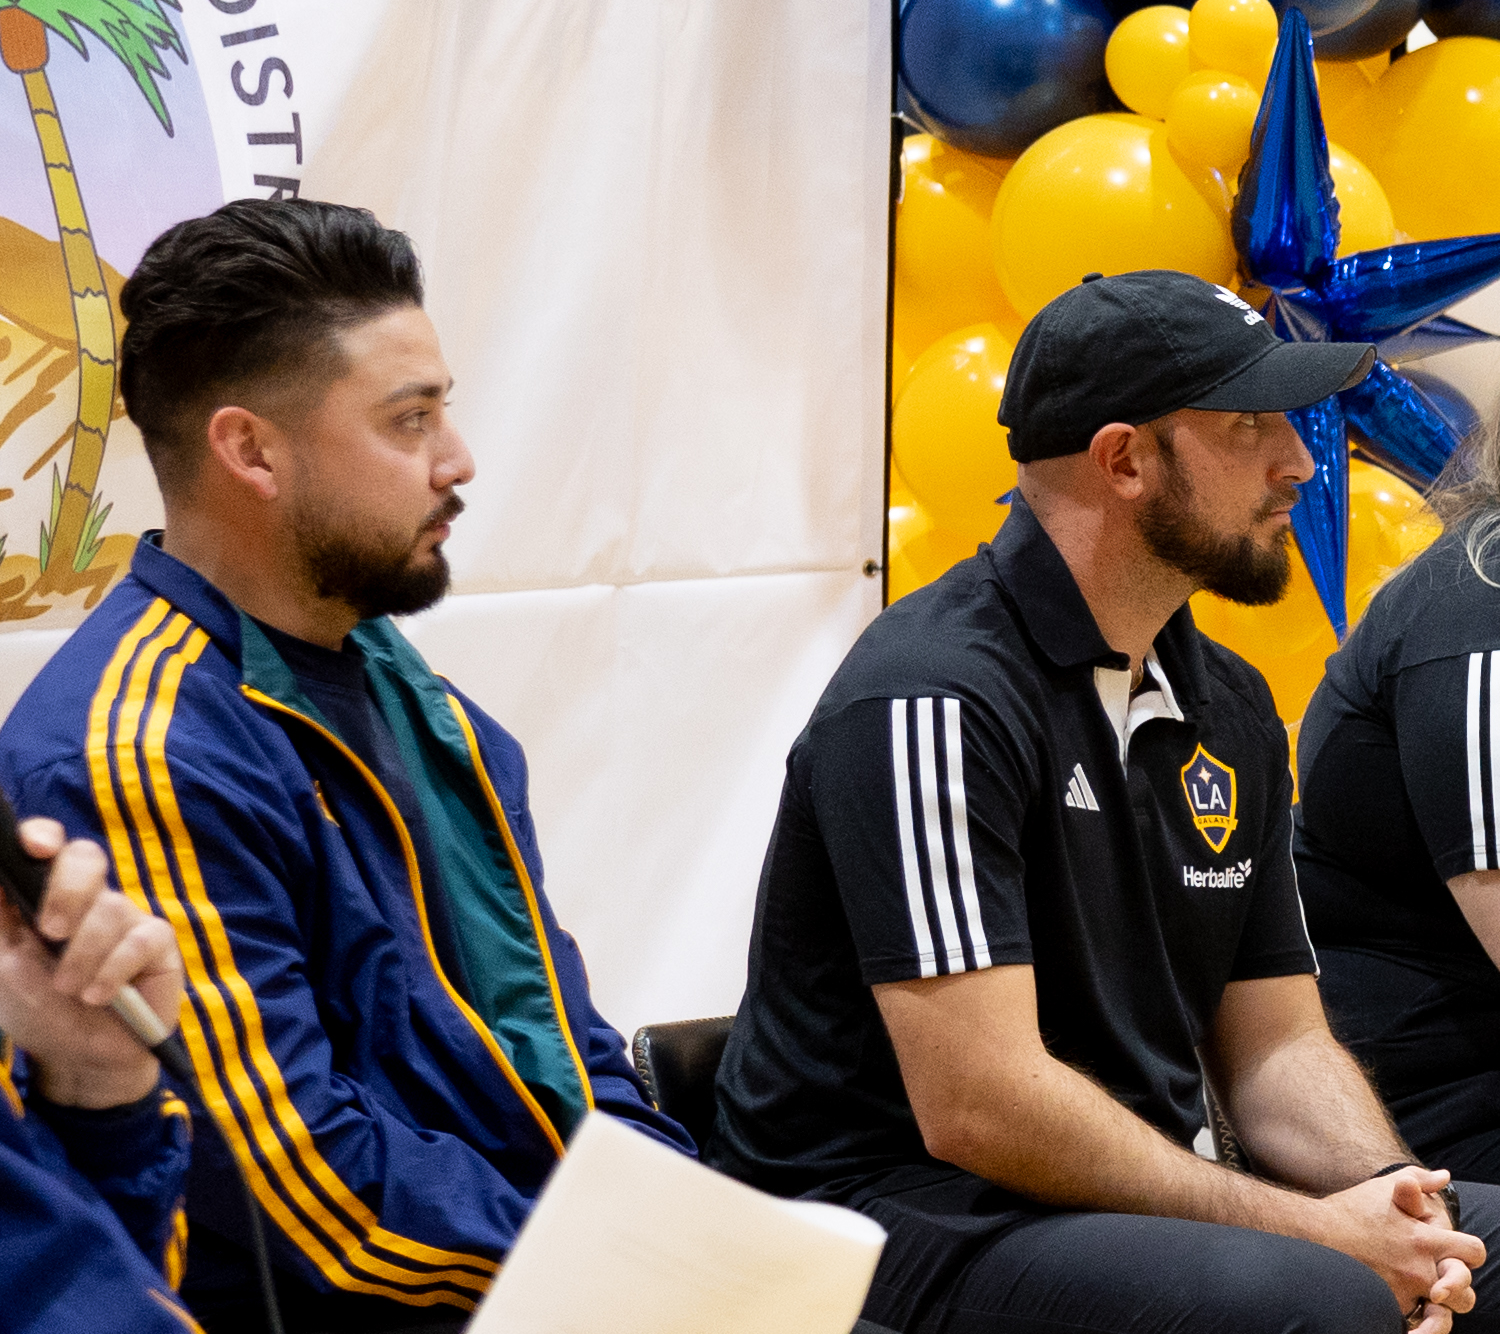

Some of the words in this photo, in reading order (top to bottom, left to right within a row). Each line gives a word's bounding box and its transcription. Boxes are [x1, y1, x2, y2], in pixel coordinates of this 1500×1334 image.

[1192, 782, 1228, 811] LA
[1197, 817, 1231, 826] GALAXY
[1182, 865, 1246, 890] Herbalife
